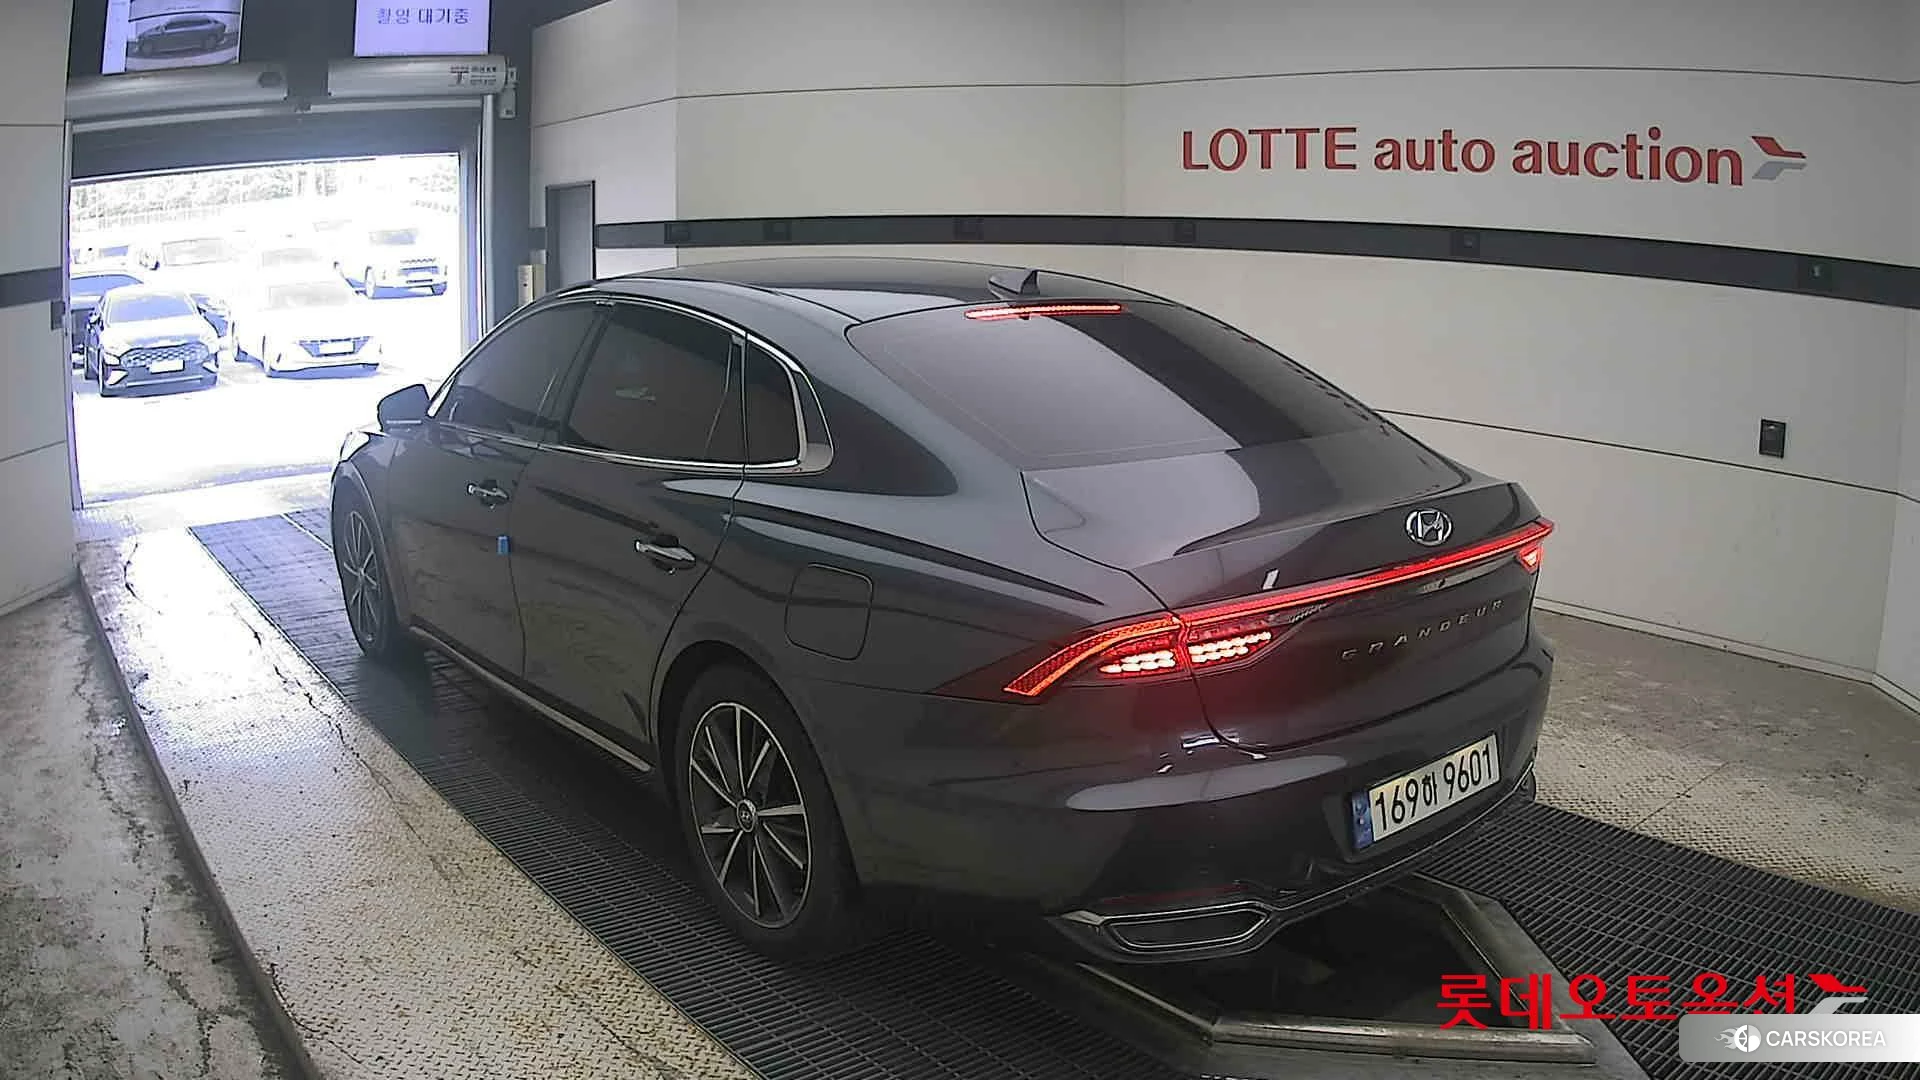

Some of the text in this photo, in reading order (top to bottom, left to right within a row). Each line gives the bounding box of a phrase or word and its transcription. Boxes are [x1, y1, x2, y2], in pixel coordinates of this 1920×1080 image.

[418, 8, 469, 24] 대기중
[1182, 126, 1744, 186] LOTTE auto auction
[1342, 599, 1504, 660] GRANDEUR
[1375, 743, 1492, 831] 169하 9601
